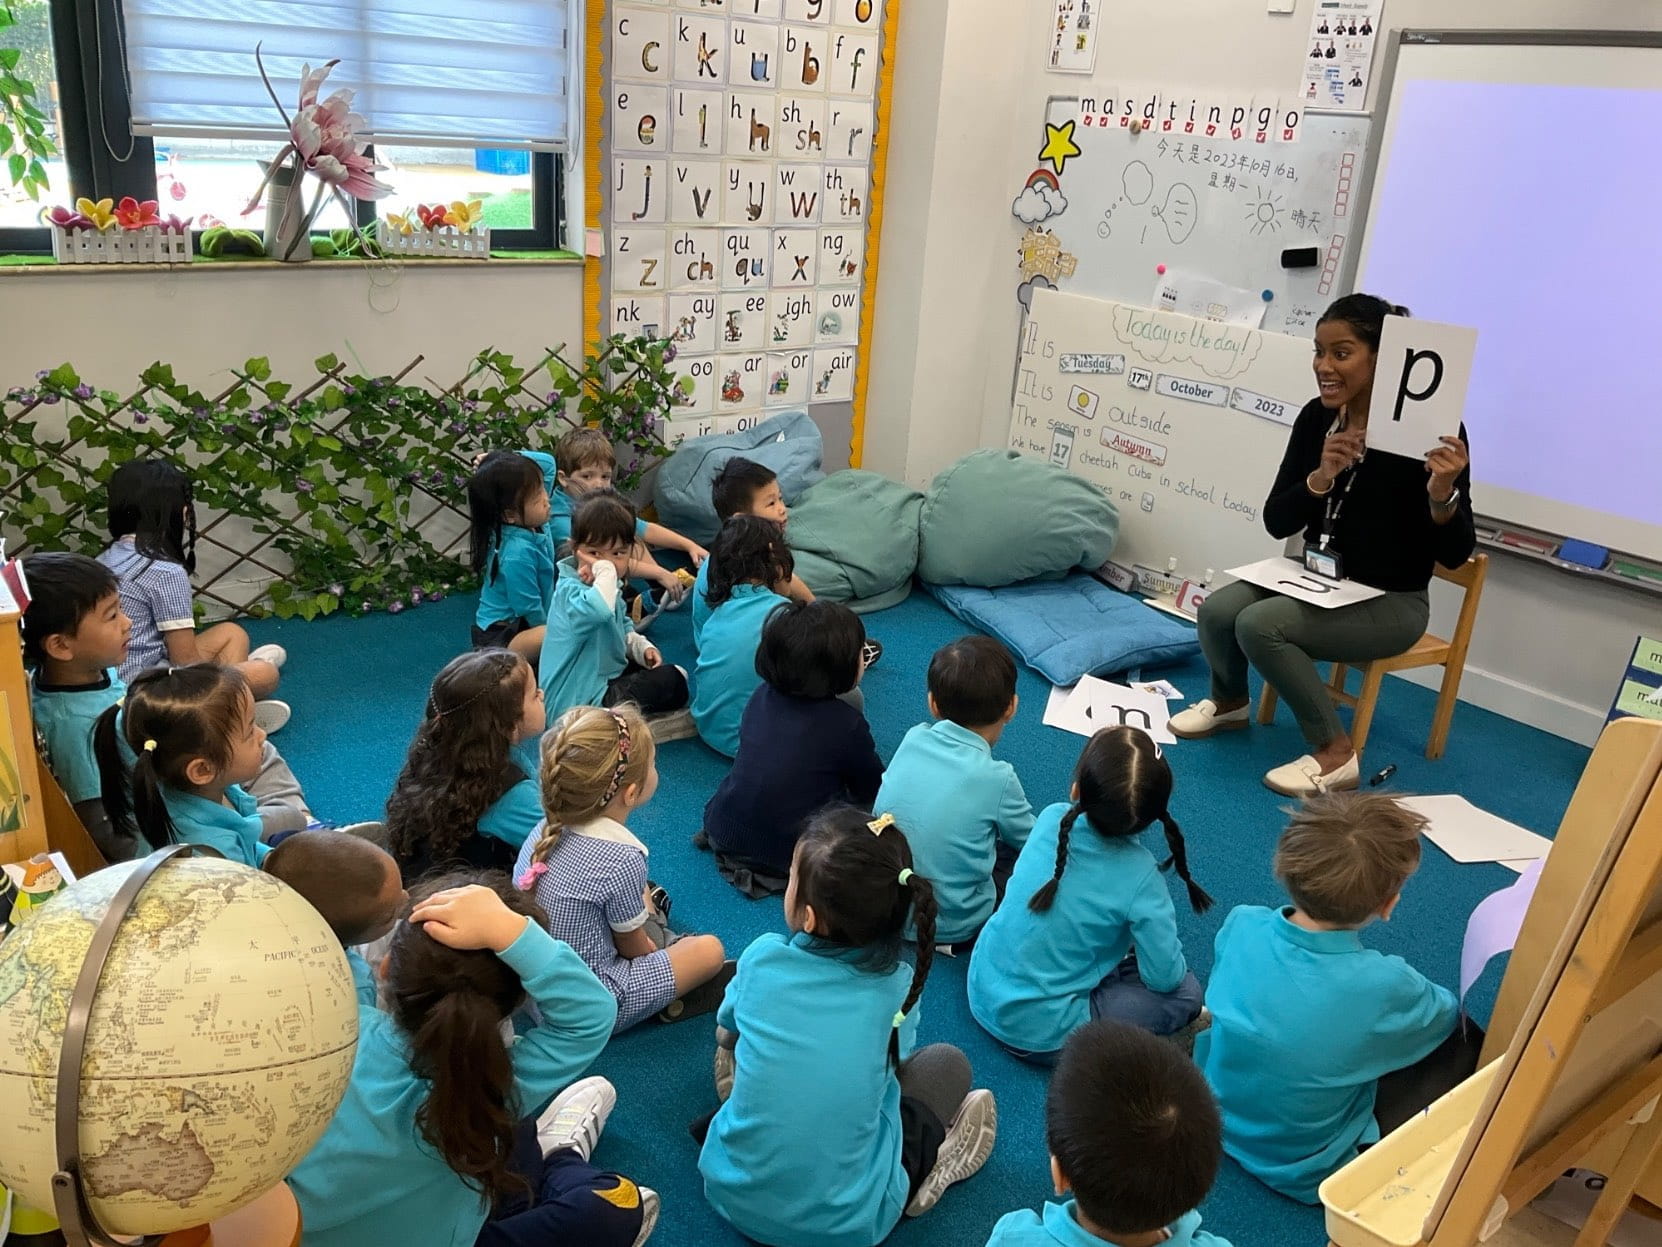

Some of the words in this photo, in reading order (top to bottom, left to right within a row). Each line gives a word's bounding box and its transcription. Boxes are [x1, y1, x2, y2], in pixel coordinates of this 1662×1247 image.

[619, 19, 629, 36] c
[679, 18, 690, 42] k
[735, 29, 745, 45] u
[786, 30, 796, 52] b
[836, 35, 844, 59] f
[618, 93, 628, 109] e
[731, 96, 742, 119] h
[782, 100, 801, 123] sh
[832, 110, 840, 125] r
[1082, 99, 1096, 113] m
[1103, 99, 1113, 115] a
[1125, 100, 1133, 115] s
[1144, 96, 1156, 119] d
[1169, 101, 1177, 120] t
[1190, 100, 1195, 121] i
[1209, 106, 1221, 123] n
[1231, 107, 1245, 130] p
[1258, 107, 1271, 131] g
[1286, 111, 1298, 128] o
[617, 163, 624, 190] j
[677, 167, 687, 182] v
[730, 169, 739, 190] y
[780, 170, 795, 185] w
[826, 168, 842, 190] th
[1208, 171, 1248, 192] 星期一
[1291, 208, 1321, 234] 晴天
[619, 237, 630, 252] z
[674, 233, 695, 255] ch
[728, 235, 750, 256] qu
[777, 236, 787, 249] x
[823, 235, 843, 254] ng
[693, 298, 714, 319] ay
[746, 297, 765, 311] ee
[786, 295, 811, 320] igh
[832, 294, 855, 307] ow
[616, 301, 640, 322] nk
[1023, 321, 1039, 355] It
[1042, 341, 1054, 358] is
[1121, 307, 1172, 358] Today
[1174, 331, 1187, 344] is
[1190, 321, 1211, 348] the
[1214, 326, 1251, 374] day!
[691, 362, 712, 376] oo
[745, 356, 762, 372] ar
[792, 353, 808, 369] or
[831, 351, 852, 369] air
[1073, 358, 1111, 371] Tuesday
[1019, 369, 1037, 398] It
[1041, 385, 1053, 401] is
[1131, 372, 1149, 384] 17th
[1392, 347, 1444, 422] p
[1170, 380, 1214, 399] October
[1254, 398, 1285, 417] 2023
[1016, 403, 1038, 427] The
[1046, 418, 1080, 433] season
[1083, 427, 1092, 437] is
[1011, 435, 1025, 449] We
[1053, 442, 1070, 460] 17
[1111, 434, 1152, 456] Autumn
[1079, 450, 1119, 471] cheetah
[1159, 476, 1170, 488] in
[1175, 478, 1215, 504] school
[1223, 492, 1257, 521] today
[1119, 489, 1133, 501] are
[1100, 565, 1126, 584] mber
[1143, 573, 1180, 592] Summe
[264, 950, 297, 962] PACIFIC
